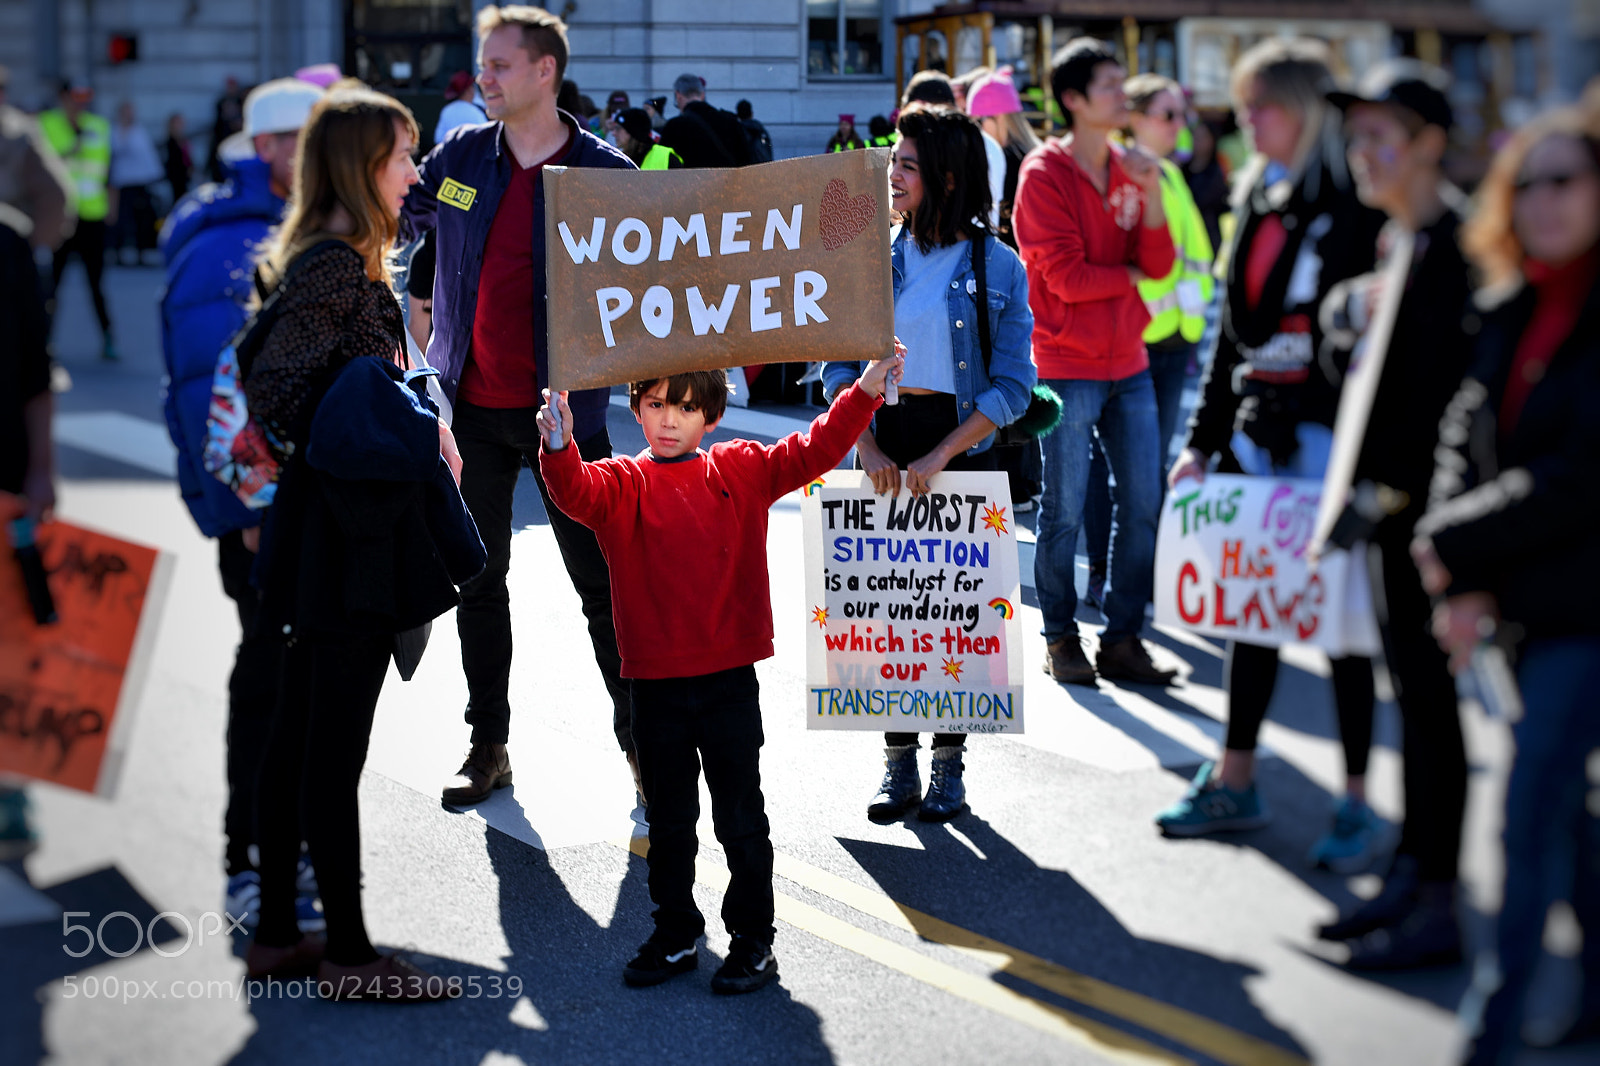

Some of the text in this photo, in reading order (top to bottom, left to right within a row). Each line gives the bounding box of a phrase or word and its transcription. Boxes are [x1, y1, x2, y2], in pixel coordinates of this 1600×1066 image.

[557, 203, 803, 265] WOMEN
[595, 270, 830, 348] POWER
[822, 493, 986, 533] THE WORST
[832, 536, 989, 568] SITUATION
[824, 568, 983, 600] is a catalyst for
[843, 594, 979, 632] our undoing
[824, 625, 1000, 656] which is then
[880, 661, 928, 681] our
[811, 687, 1014, 720] TRANSFORMATION
